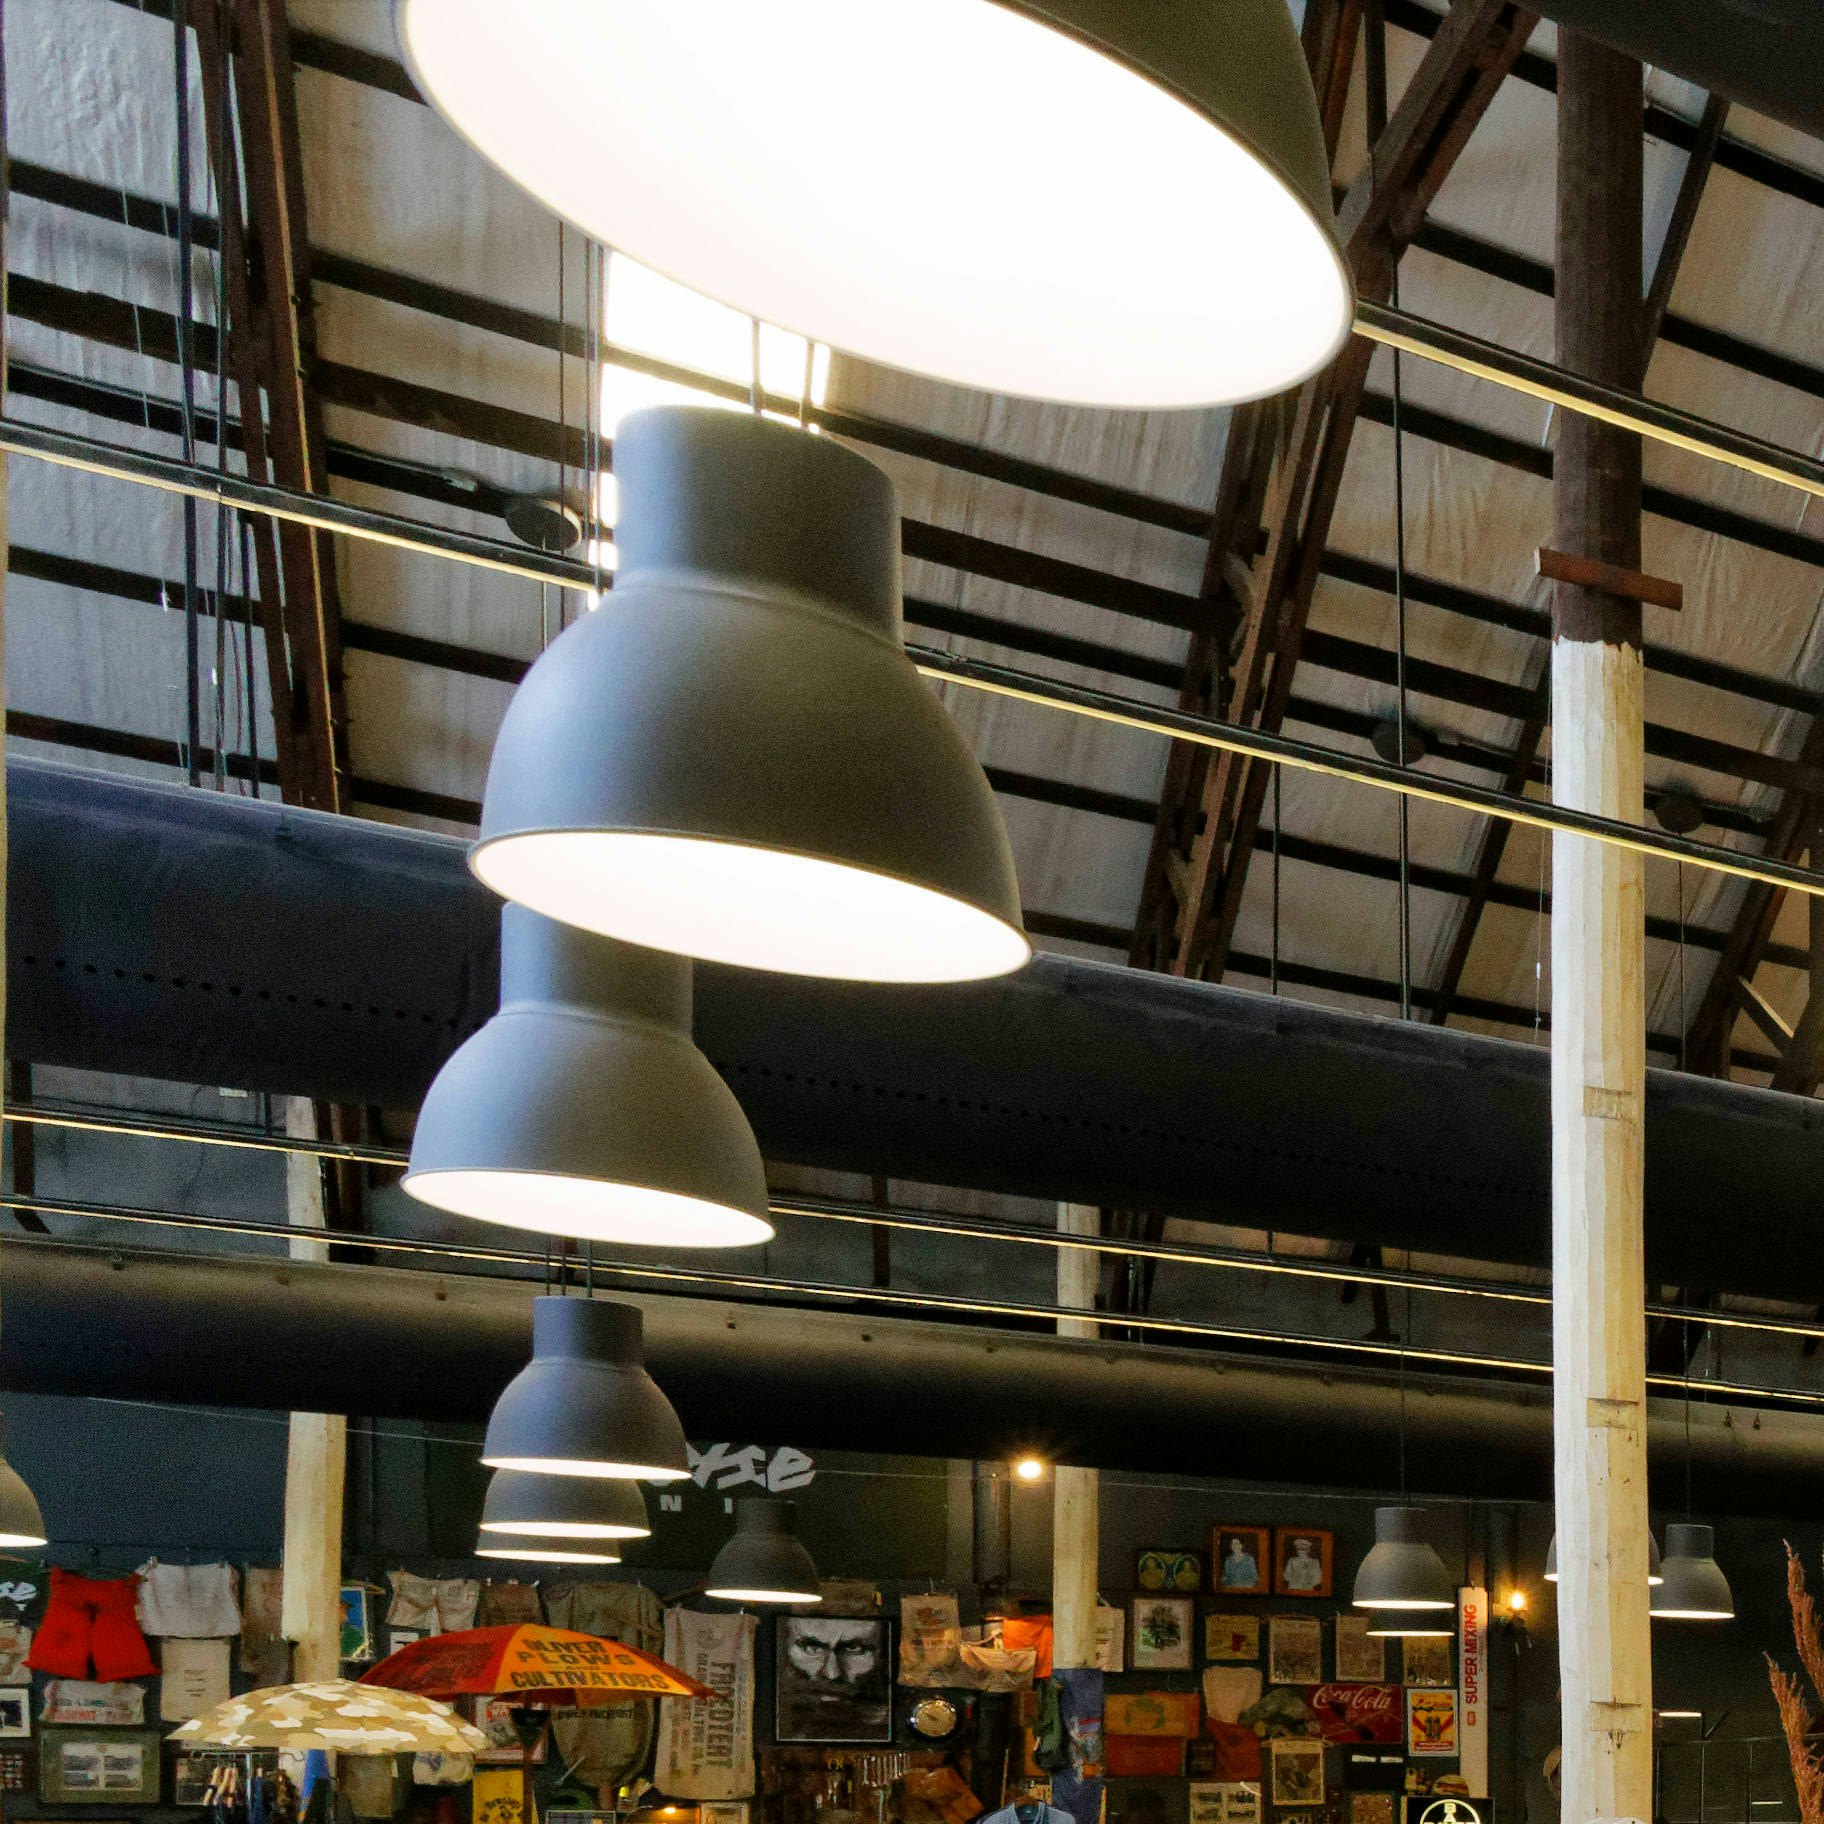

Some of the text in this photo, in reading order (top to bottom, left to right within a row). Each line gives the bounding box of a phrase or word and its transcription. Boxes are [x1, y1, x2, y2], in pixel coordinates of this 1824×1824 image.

[516, 1651, 637, 1666] PLOWS
[1463, 1603, 1478, 1705] SUPER MIXING
[510, 1670, 671, 1690] CULTIVATORS
